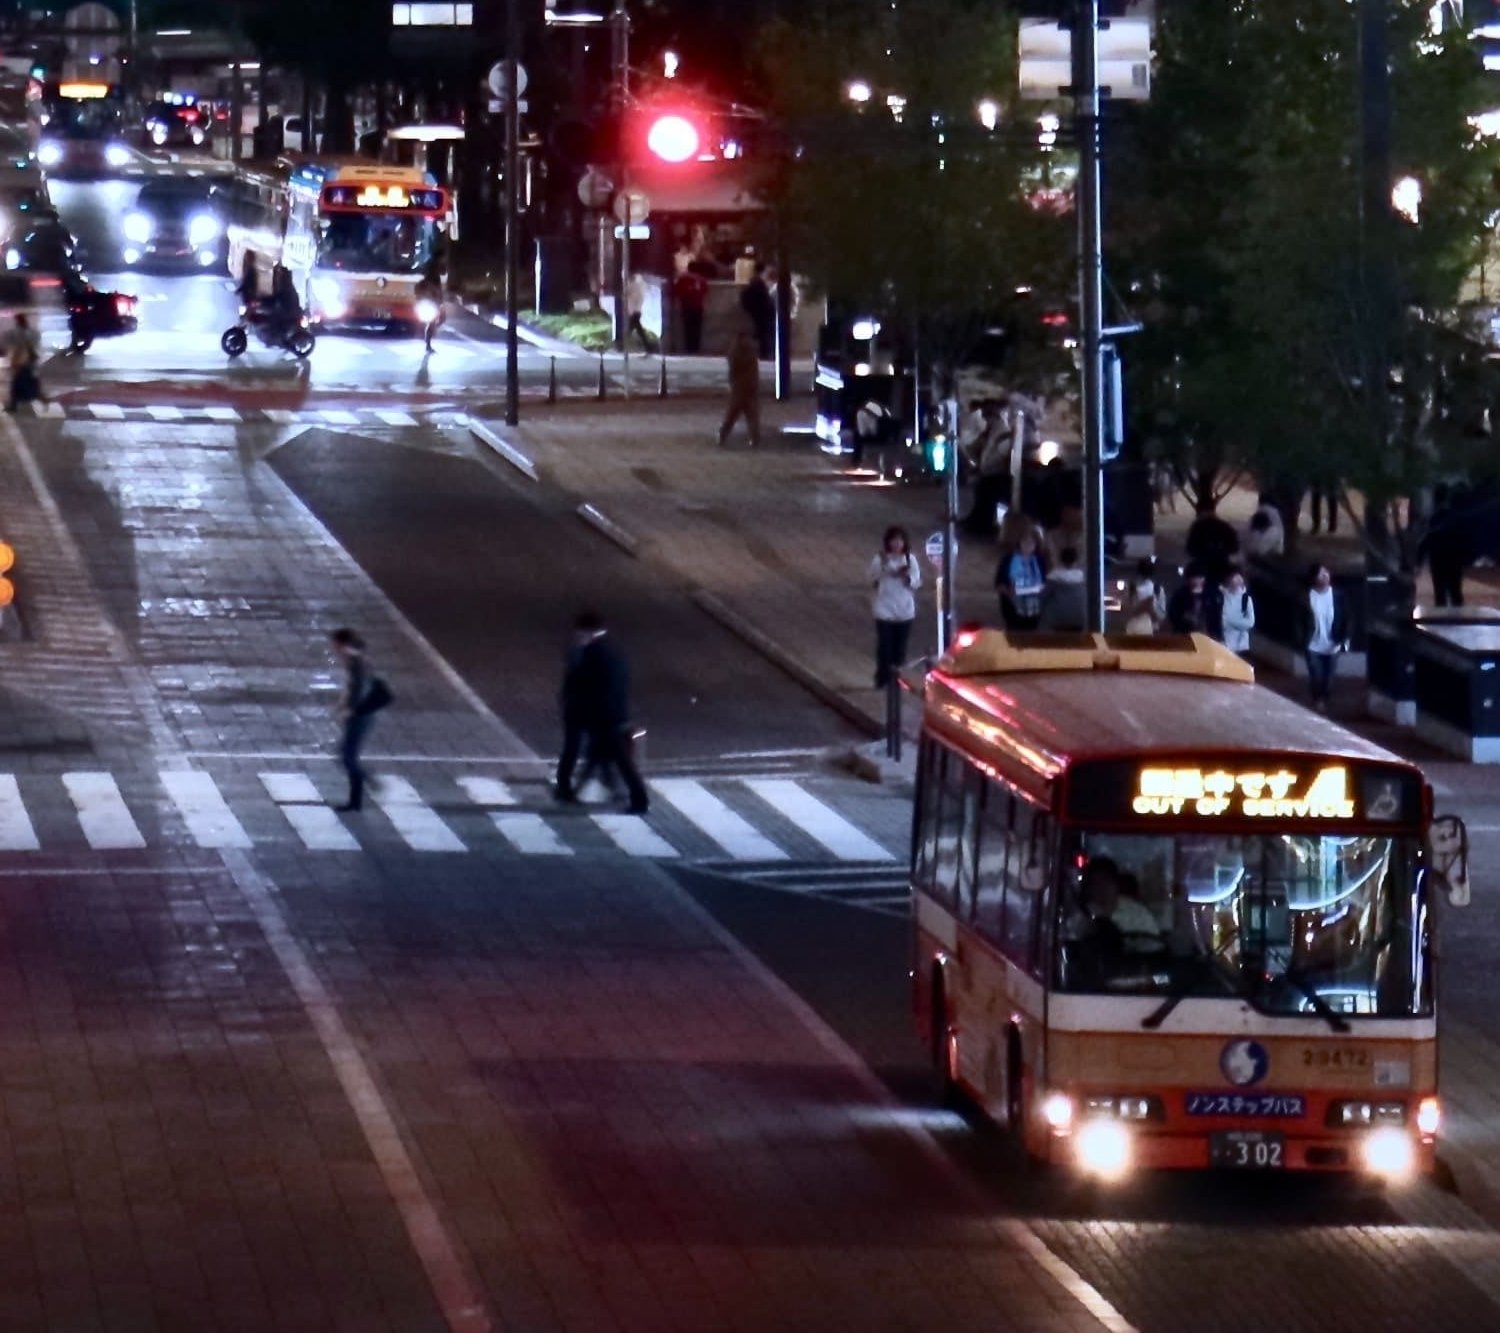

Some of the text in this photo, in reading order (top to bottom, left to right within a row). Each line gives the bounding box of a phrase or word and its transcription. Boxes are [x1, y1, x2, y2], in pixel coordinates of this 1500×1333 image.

[1133, 796, 1354, 818] OUT OF SERVICE
[1188, 1096, 1302, 1115] ノンステップバス
